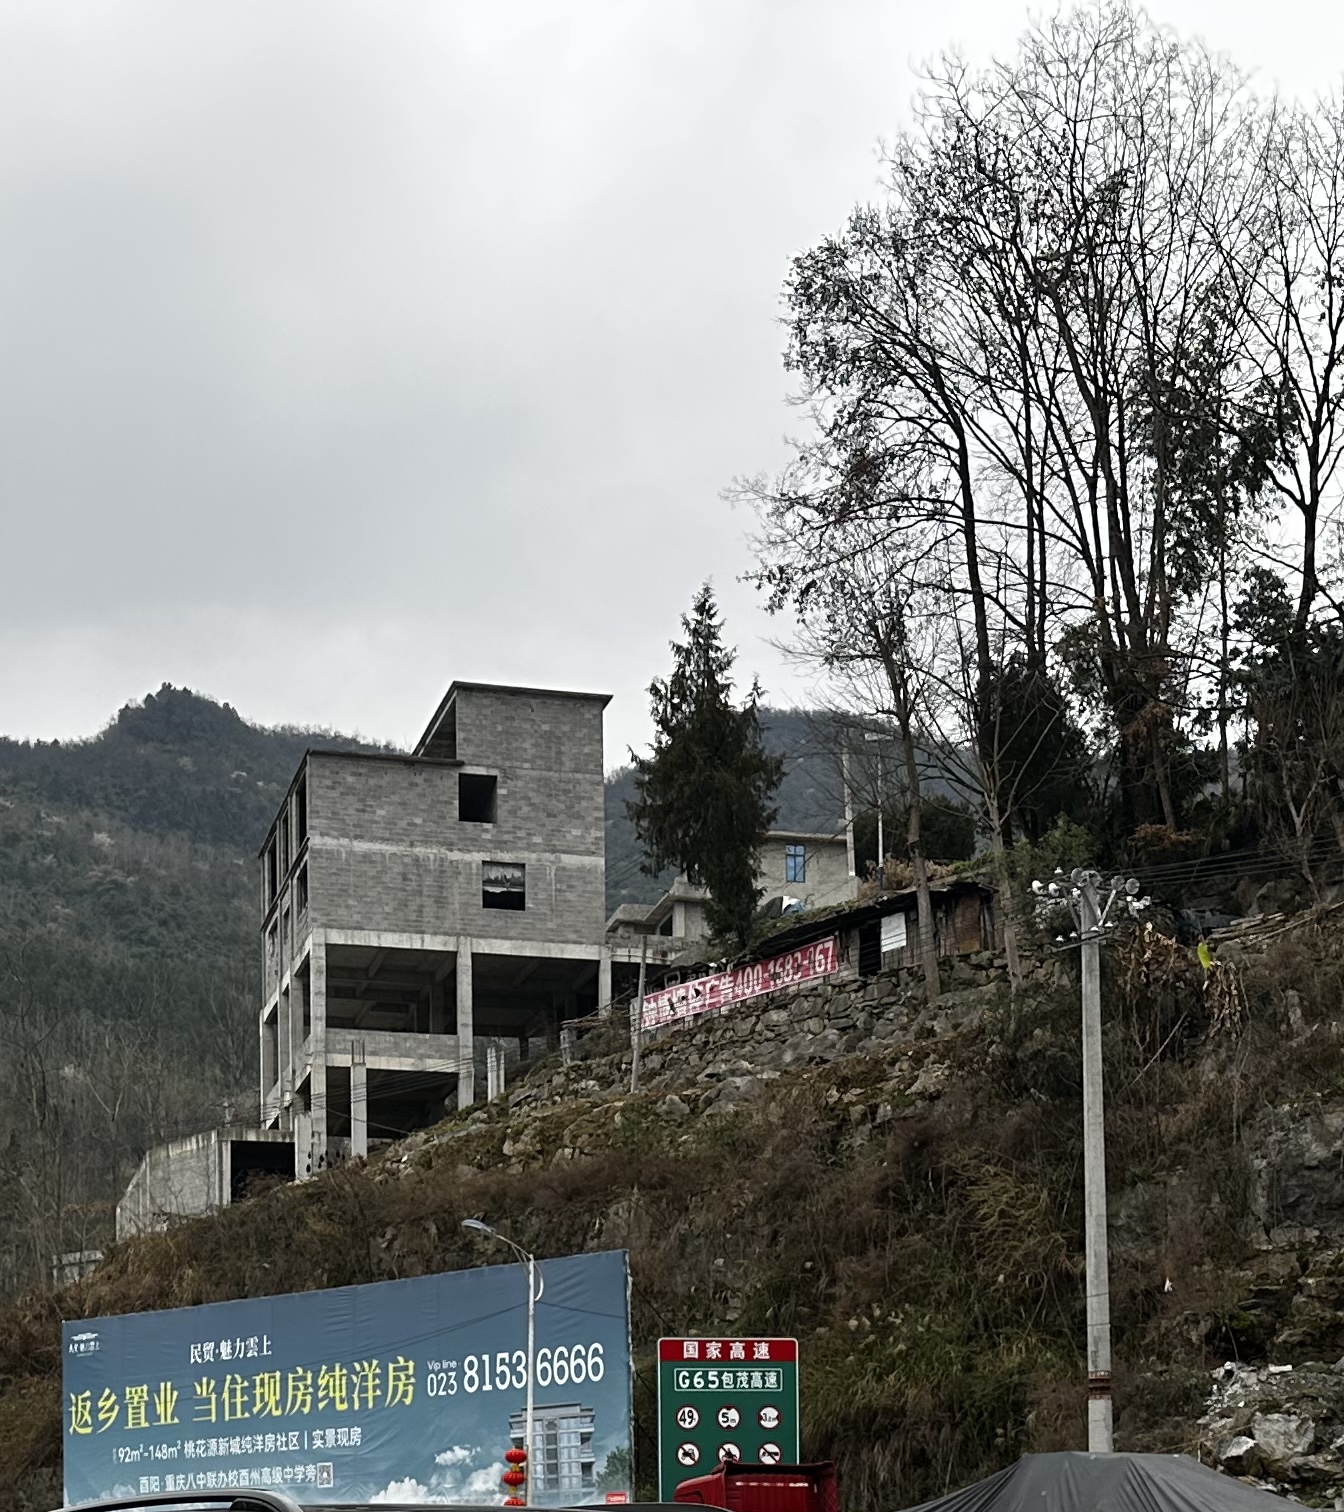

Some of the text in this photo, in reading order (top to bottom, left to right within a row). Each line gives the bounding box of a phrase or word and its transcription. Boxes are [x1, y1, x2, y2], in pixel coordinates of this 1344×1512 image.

[683, 1341, 770, 1360] 国家高速
[427, 1342, 605, 1397] 023 8153 6666
[678, 1370, 778, 1388] G65包茂高速
[68, 1356, 417, 1436] 返乡置业 当住现房纯洋房
